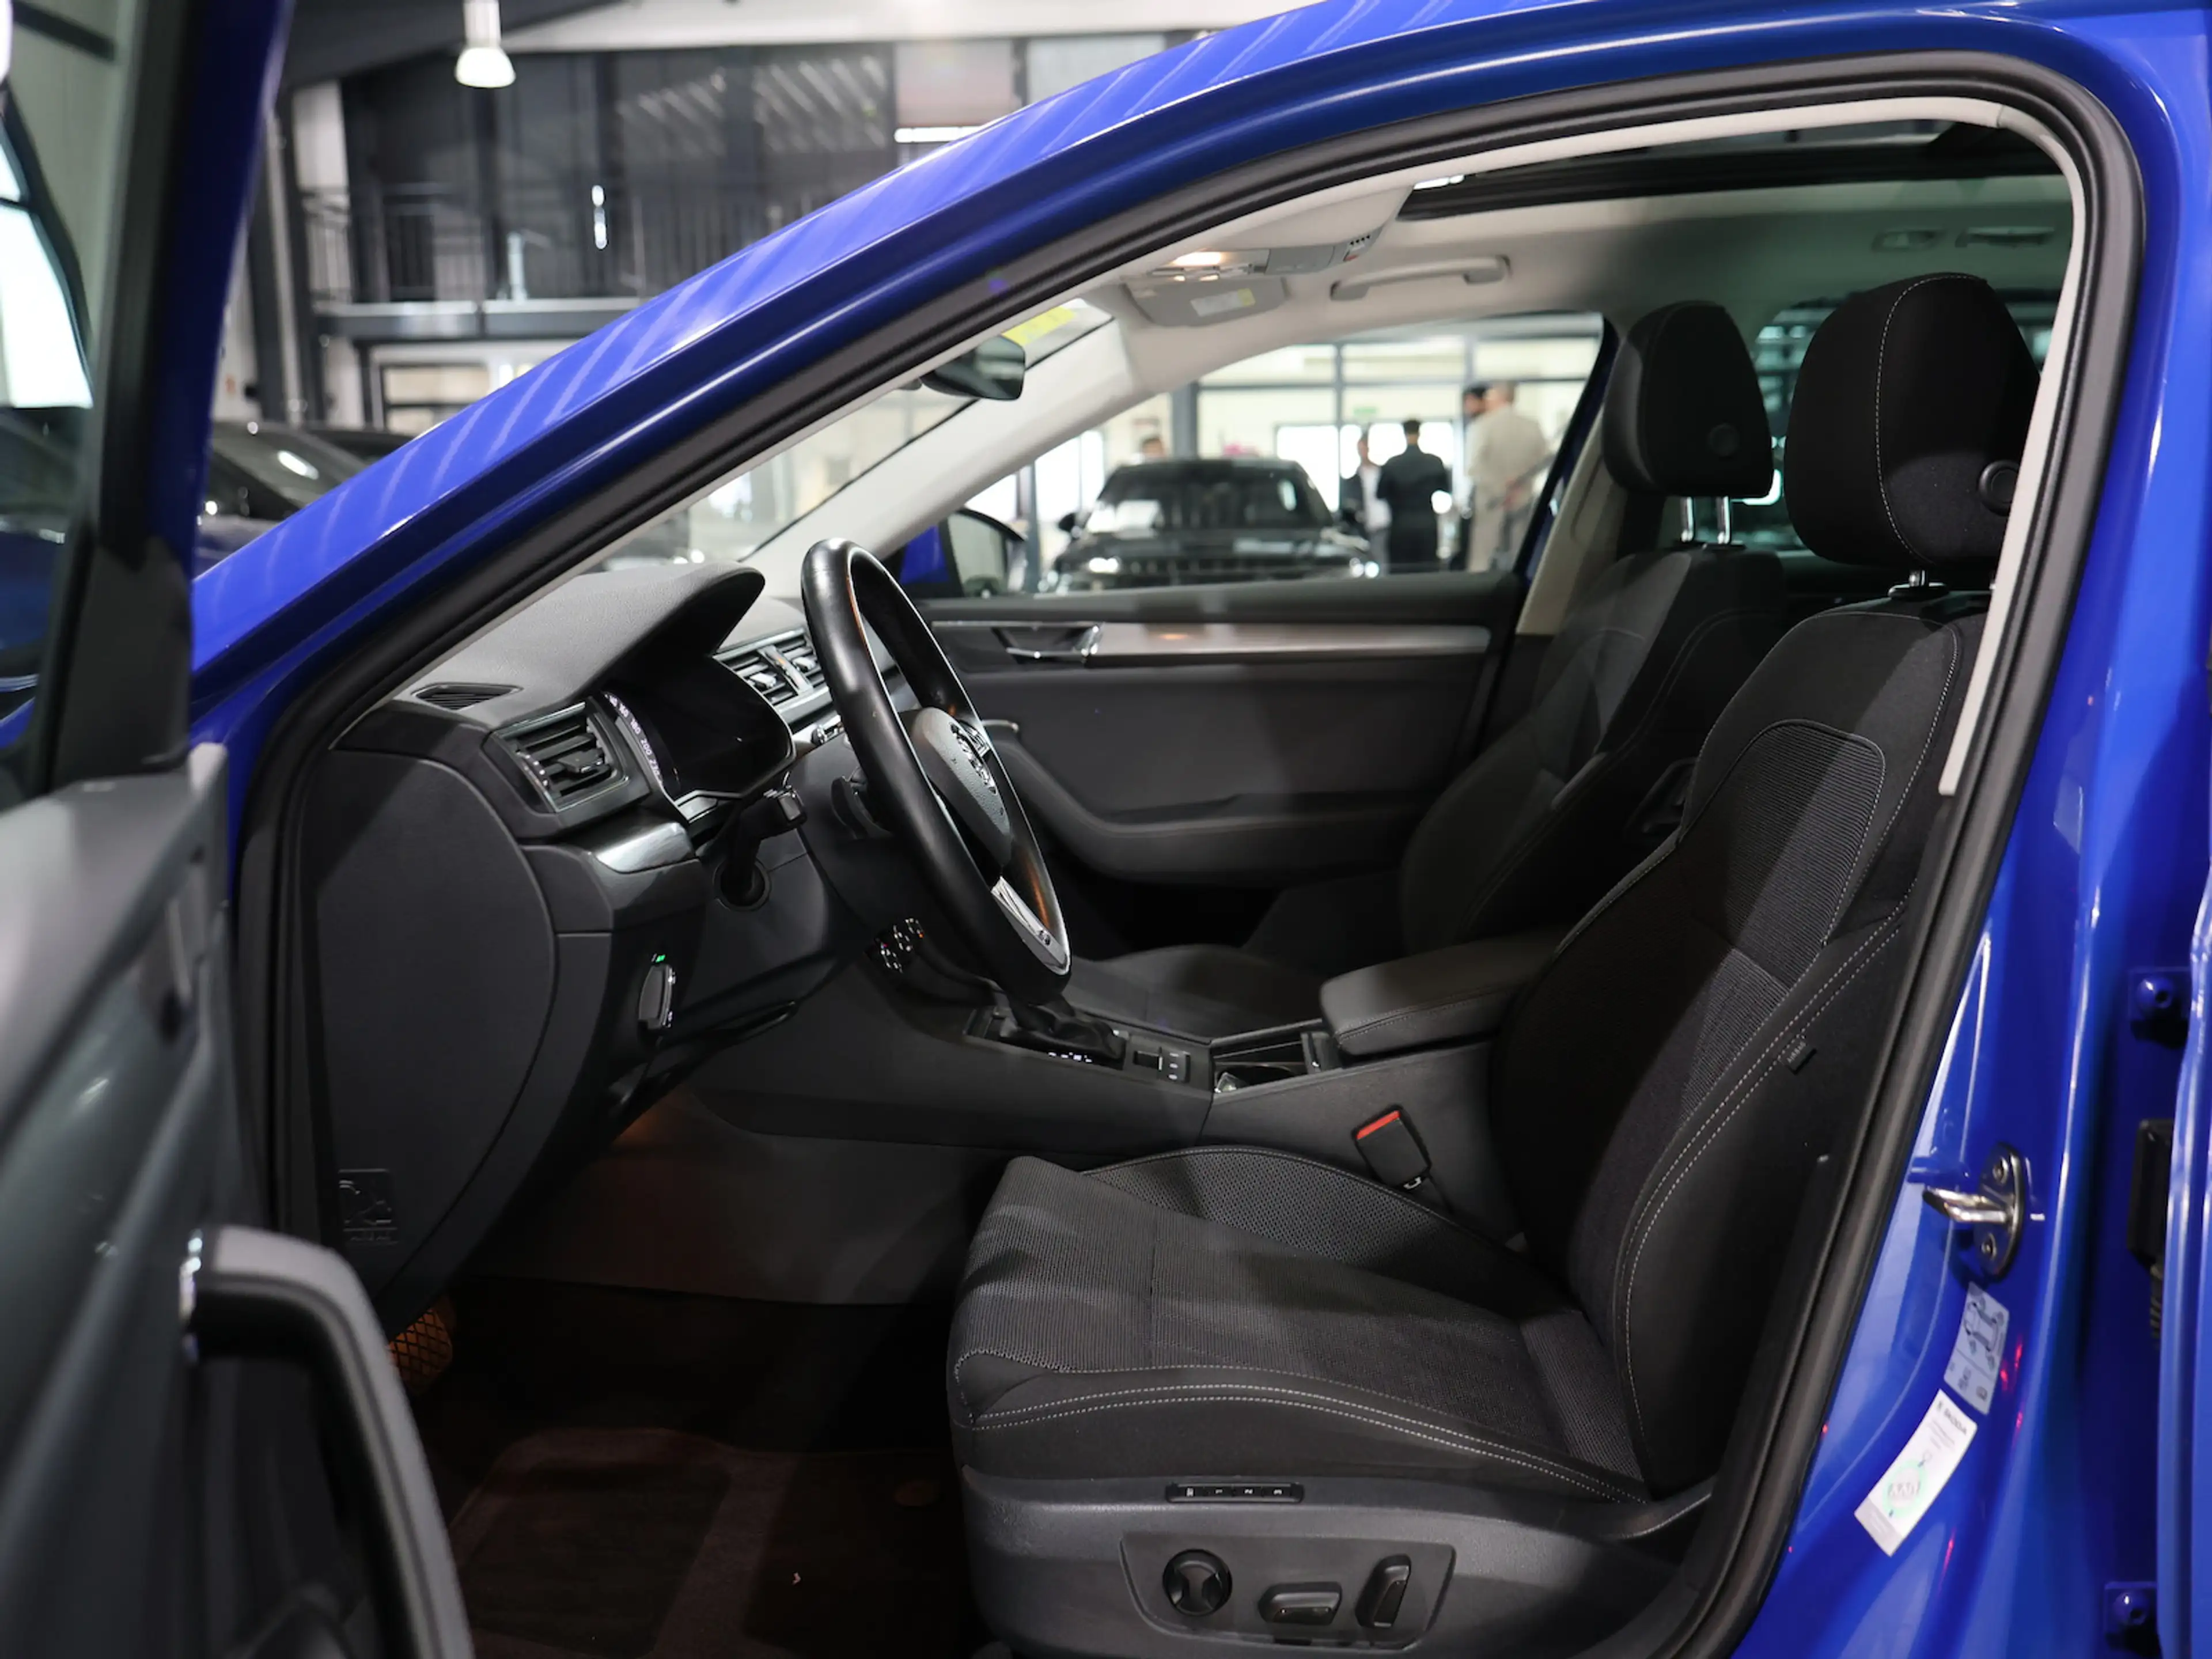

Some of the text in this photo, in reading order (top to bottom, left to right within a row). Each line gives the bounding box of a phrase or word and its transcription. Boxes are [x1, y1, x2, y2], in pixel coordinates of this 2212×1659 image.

[630, 718, 641, 734] 180
[640, 738, 652, 755] 200
[1786, 1041, 1806, 1063] AIRBAG
